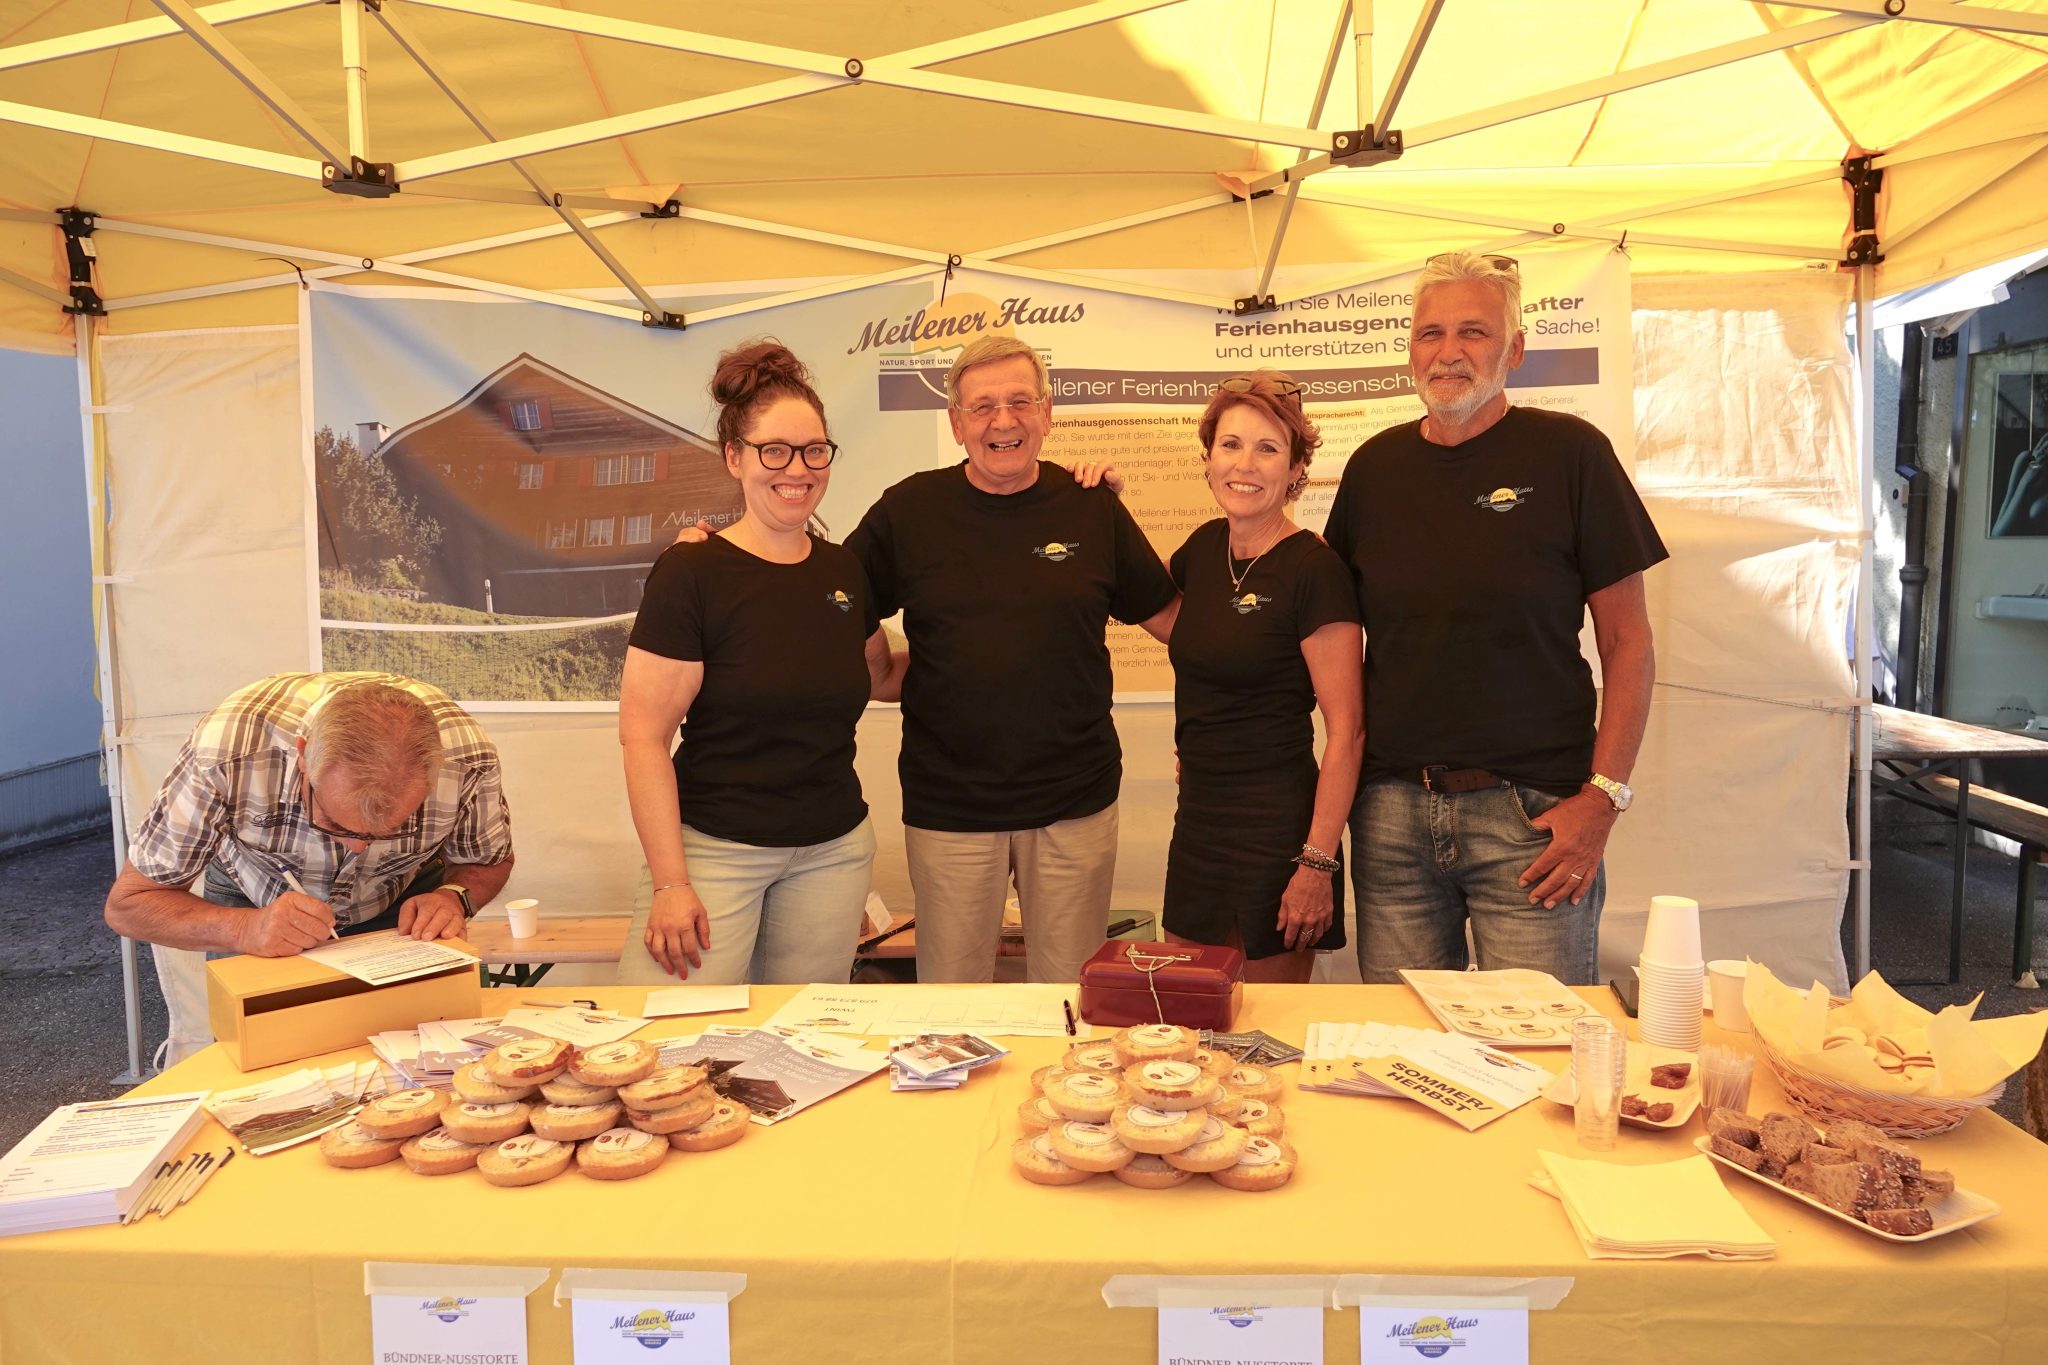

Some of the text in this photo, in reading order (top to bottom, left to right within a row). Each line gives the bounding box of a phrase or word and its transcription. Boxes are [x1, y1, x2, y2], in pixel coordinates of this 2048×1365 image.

[1300, 297, 1330, 311] Sie
[1337, 291, 1413, 309] Meilene
[1523, 296, 1584, 314] after
[847, 297, 1085, 355] Meilener Haus
[1215, 344, 1253, 358] und
[1260, 340, 1387, 358] unterstützen
[1393, 337, 1410, 353] Si
[1535, 317, 1600, 335] Sache!
[880, 359, 907, 367] NATUR,
[910, 358, 935, 366] SPORT
[1050, 416, 1180, 430] erienhausgenossenschaft
[1087, 431, 1115, 441] wurde
[1133, 430, 1154, 440] dem
[1063, 447, 1087, 456] Haus
[1089, 447, 1108, 456] eine
[1110, 446, 1131, 457] gute
[1128, 473, 1140, 482] für
[1173, 506, 1197, 517] Haus
[1386, 1071, 1472, 1112] HERBST
[1391, 1062, 1494, 1111] SOMMER/
[609, 1308, 695, 1329] Meilener Haus
[1386, 1316, 1478, 1338] Meilener Haus
[383, 1351, 519, 1365] BÜNDNER-NUSSTORTE
